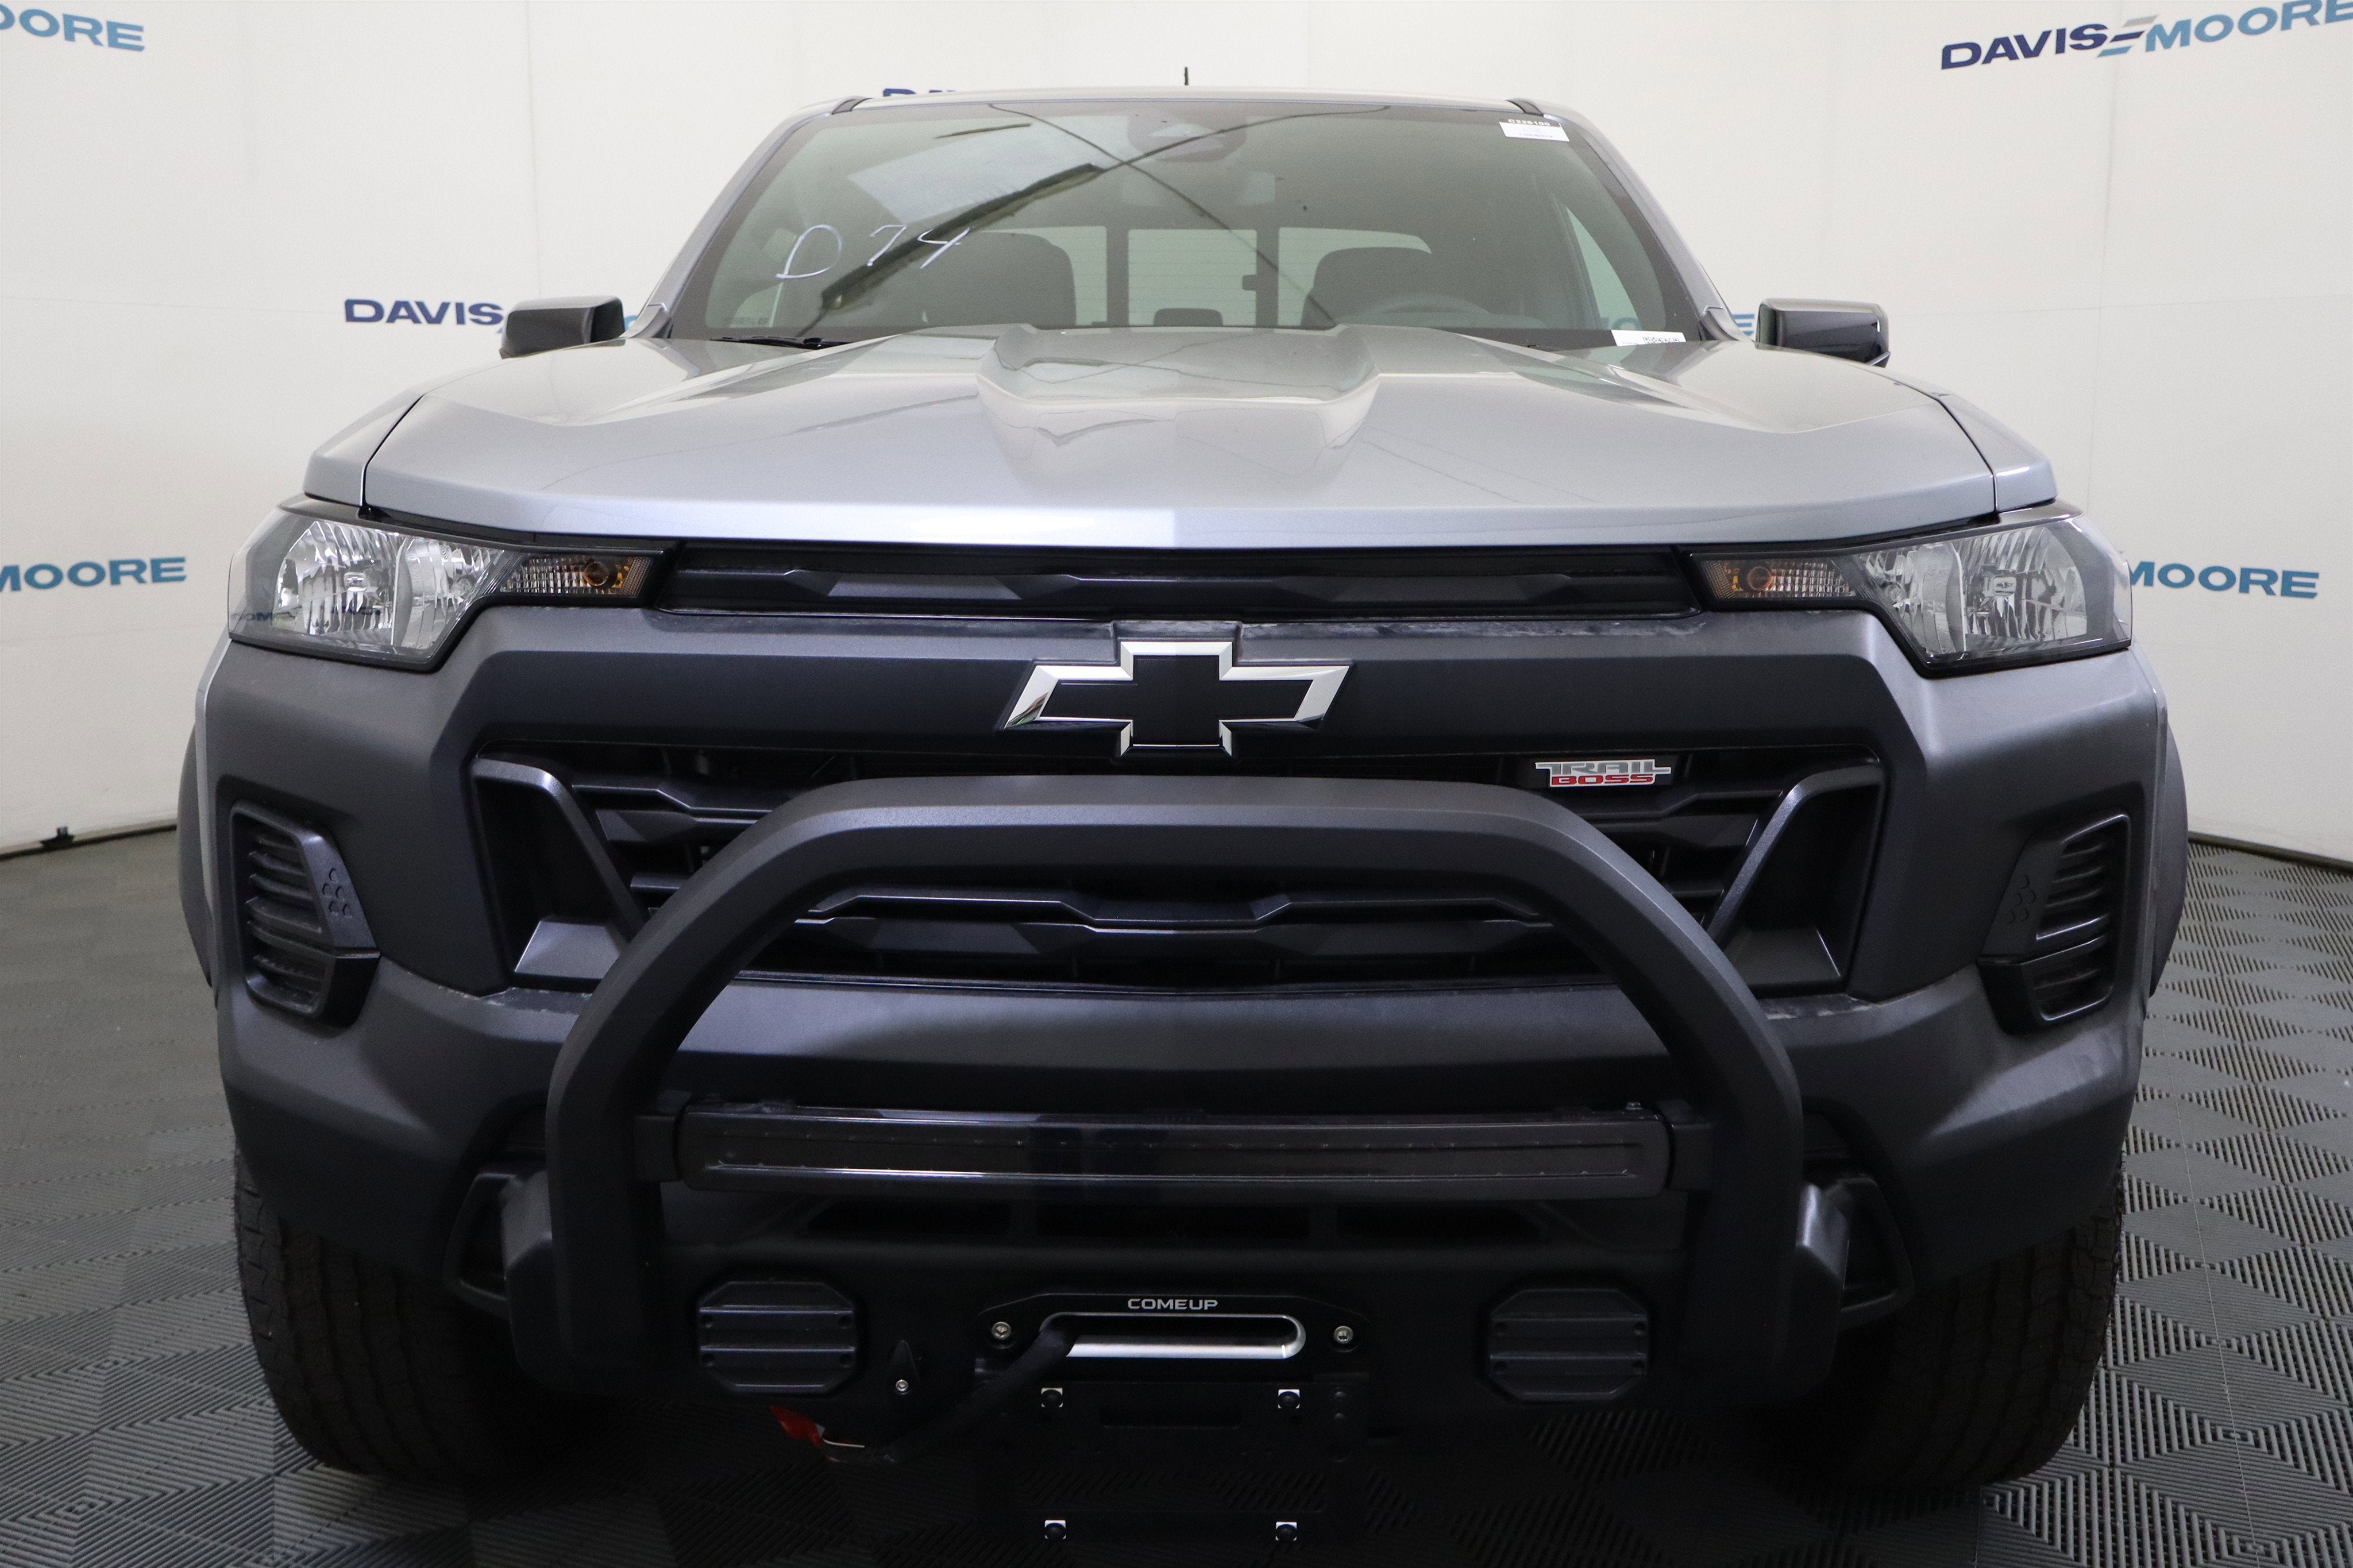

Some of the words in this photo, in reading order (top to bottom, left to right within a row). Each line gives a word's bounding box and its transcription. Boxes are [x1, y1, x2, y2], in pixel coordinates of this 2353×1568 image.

[1941, 24, 2108, 69] DAVIS
[344, 299, 504, 326] DAVIS
[1535, 759, 1672, 775] TRAIL
[1550, 774, 1655, 787] BOSS
[1128, 1298, 1218, 1310] COMEUP
